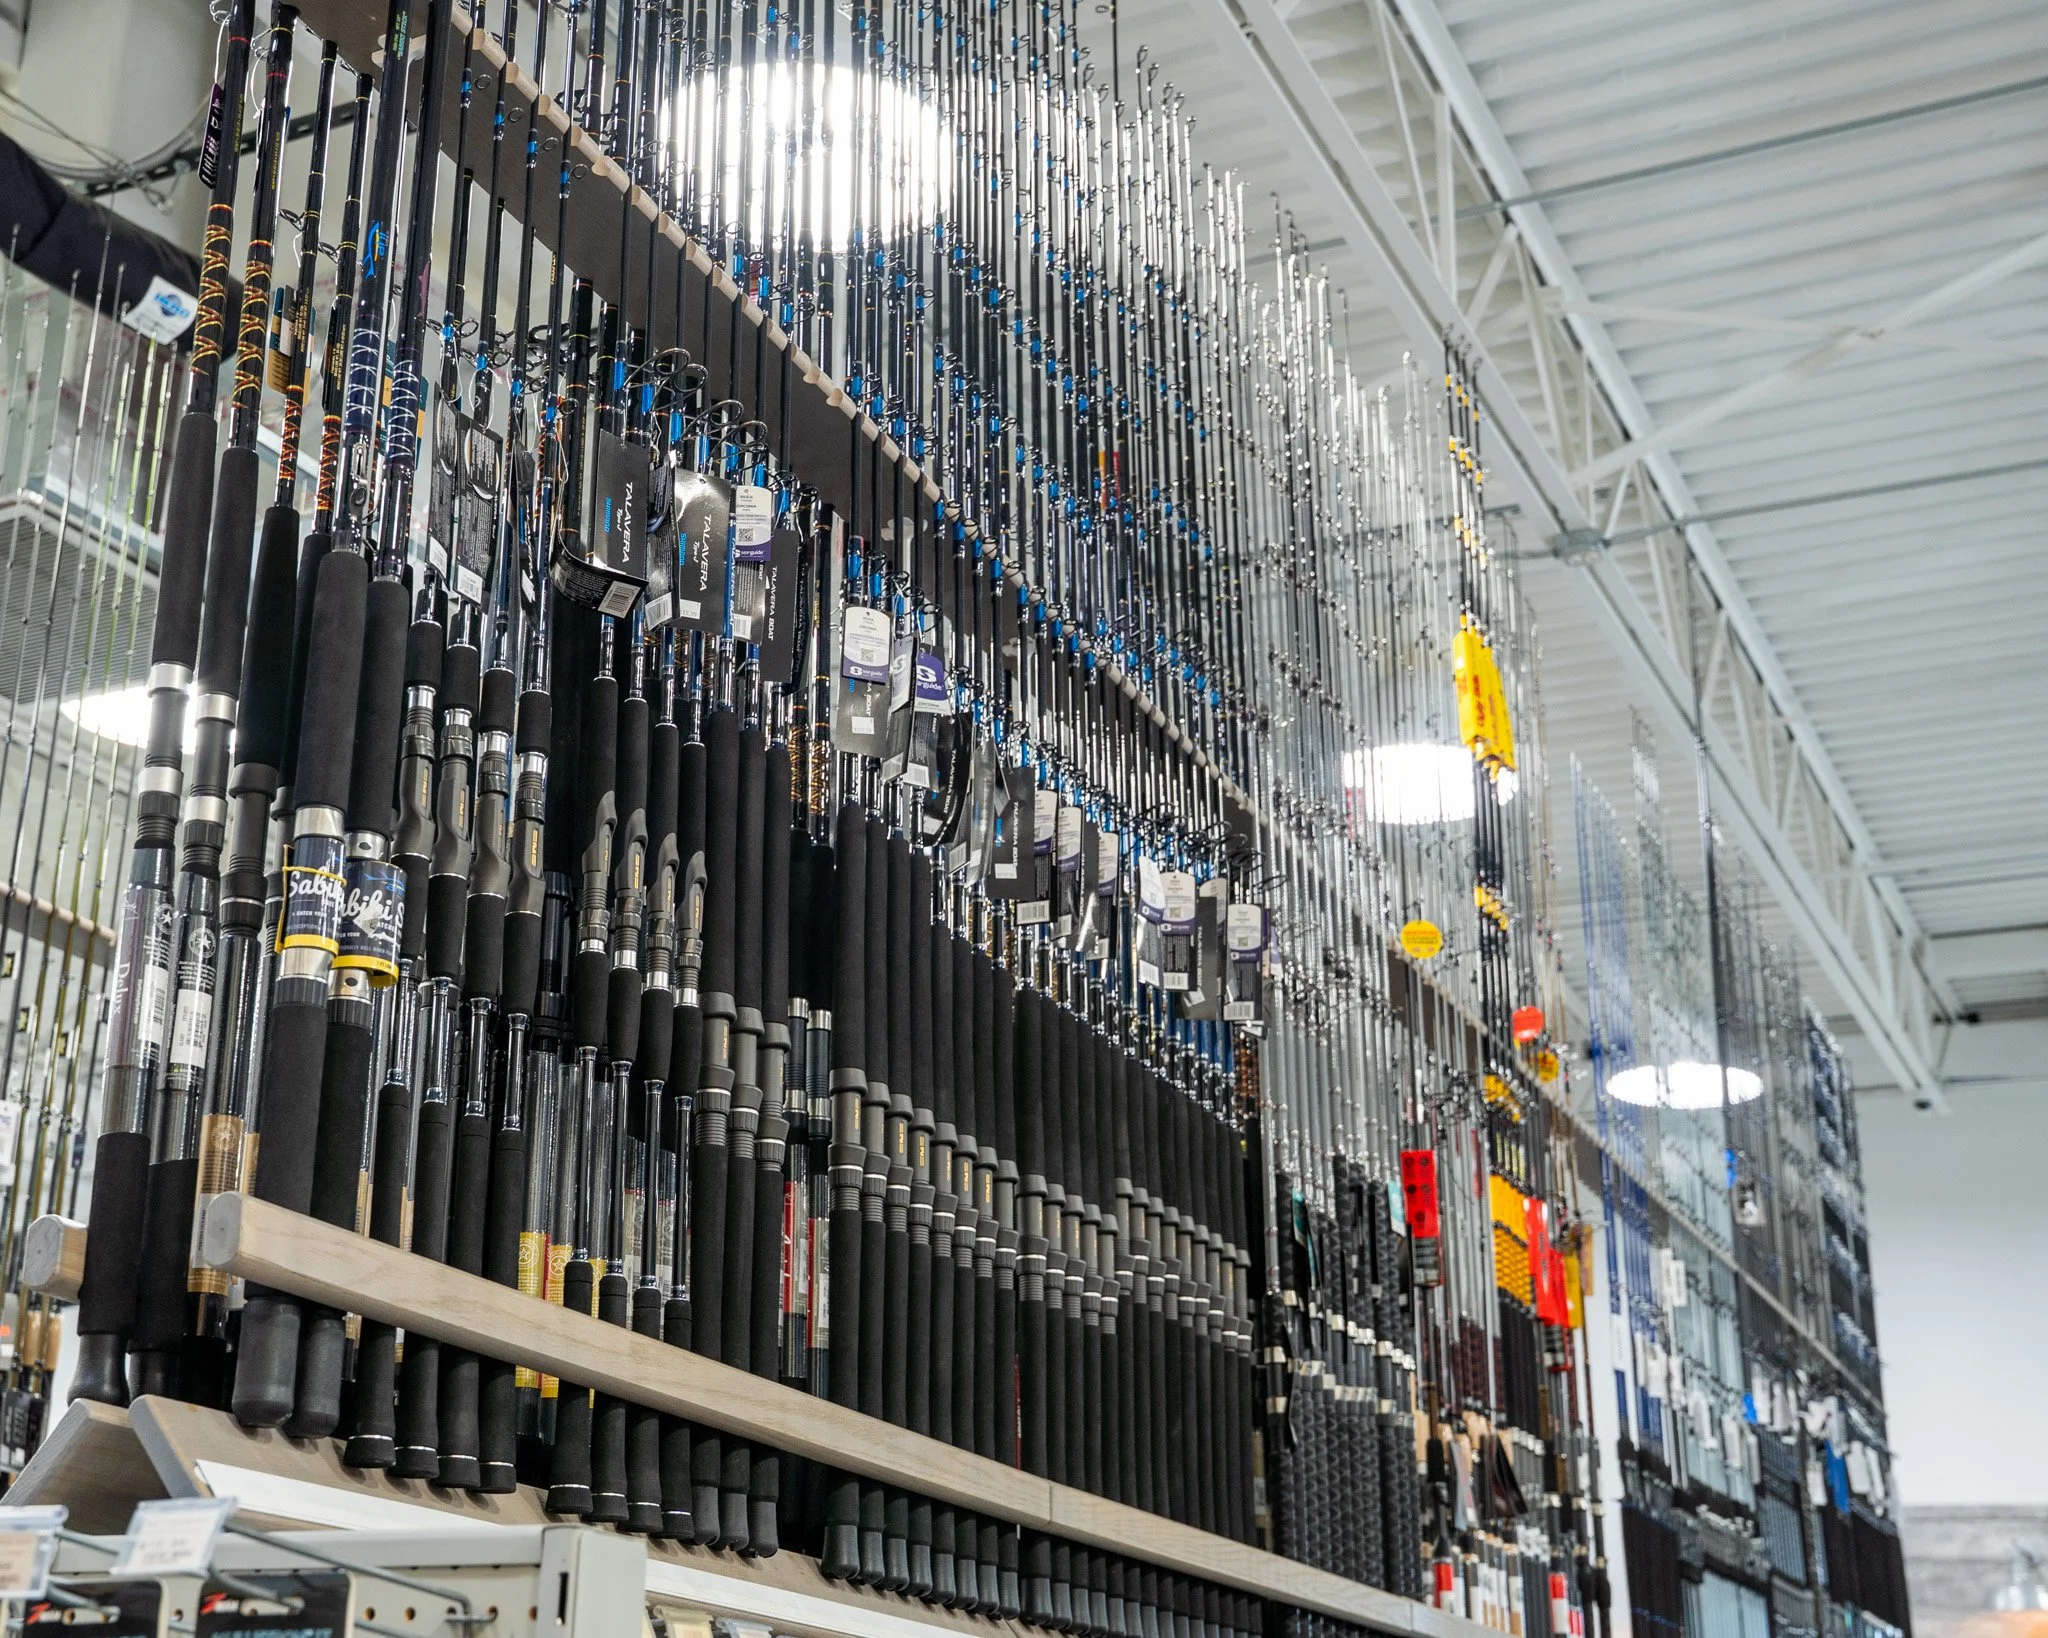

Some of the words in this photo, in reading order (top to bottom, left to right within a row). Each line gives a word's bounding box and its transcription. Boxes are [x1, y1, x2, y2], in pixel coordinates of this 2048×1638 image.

[604, 496, 612, 533] SHIMANO
[622, 482, 633, 563] TALAVERA
[700, 514, 712, 592] TALAVERA
[769, 566, 777, 616] TALAVERA
